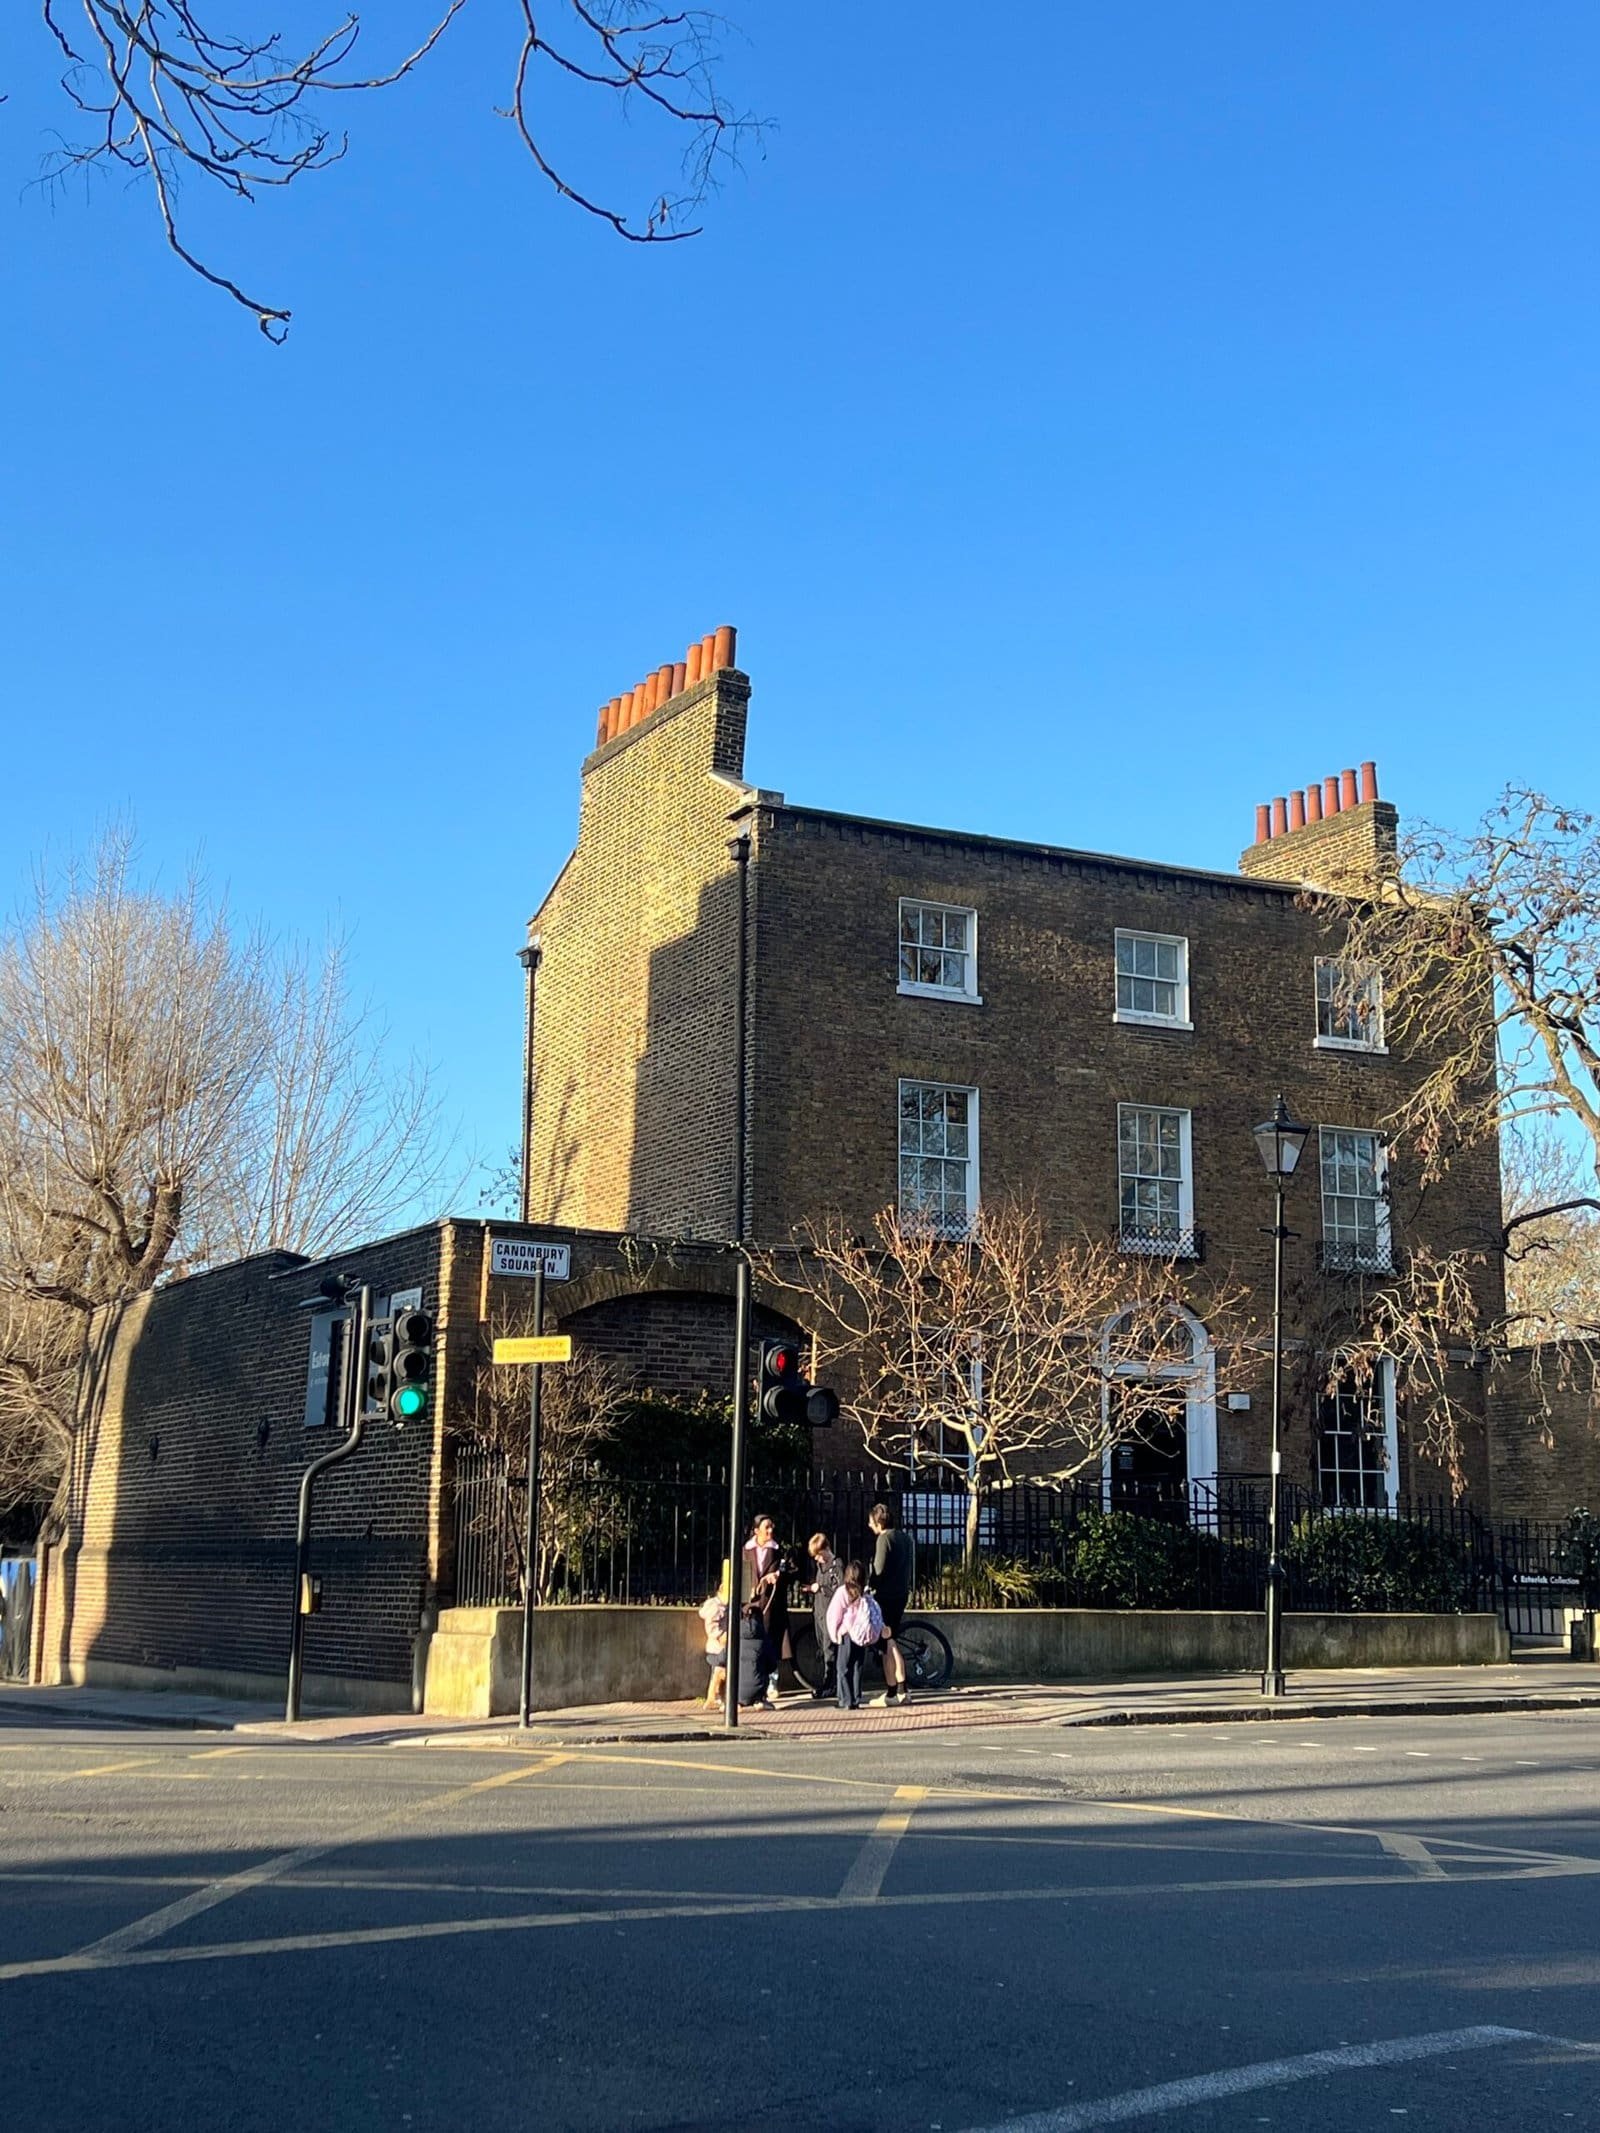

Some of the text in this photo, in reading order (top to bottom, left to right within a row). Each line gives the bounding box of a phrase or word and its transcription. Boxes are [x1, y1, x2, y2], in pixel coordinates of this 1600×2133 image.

[496, 1244, 564, 1260] CANONBURY
[500, 1258, 560, 1274] SQUAR N.
